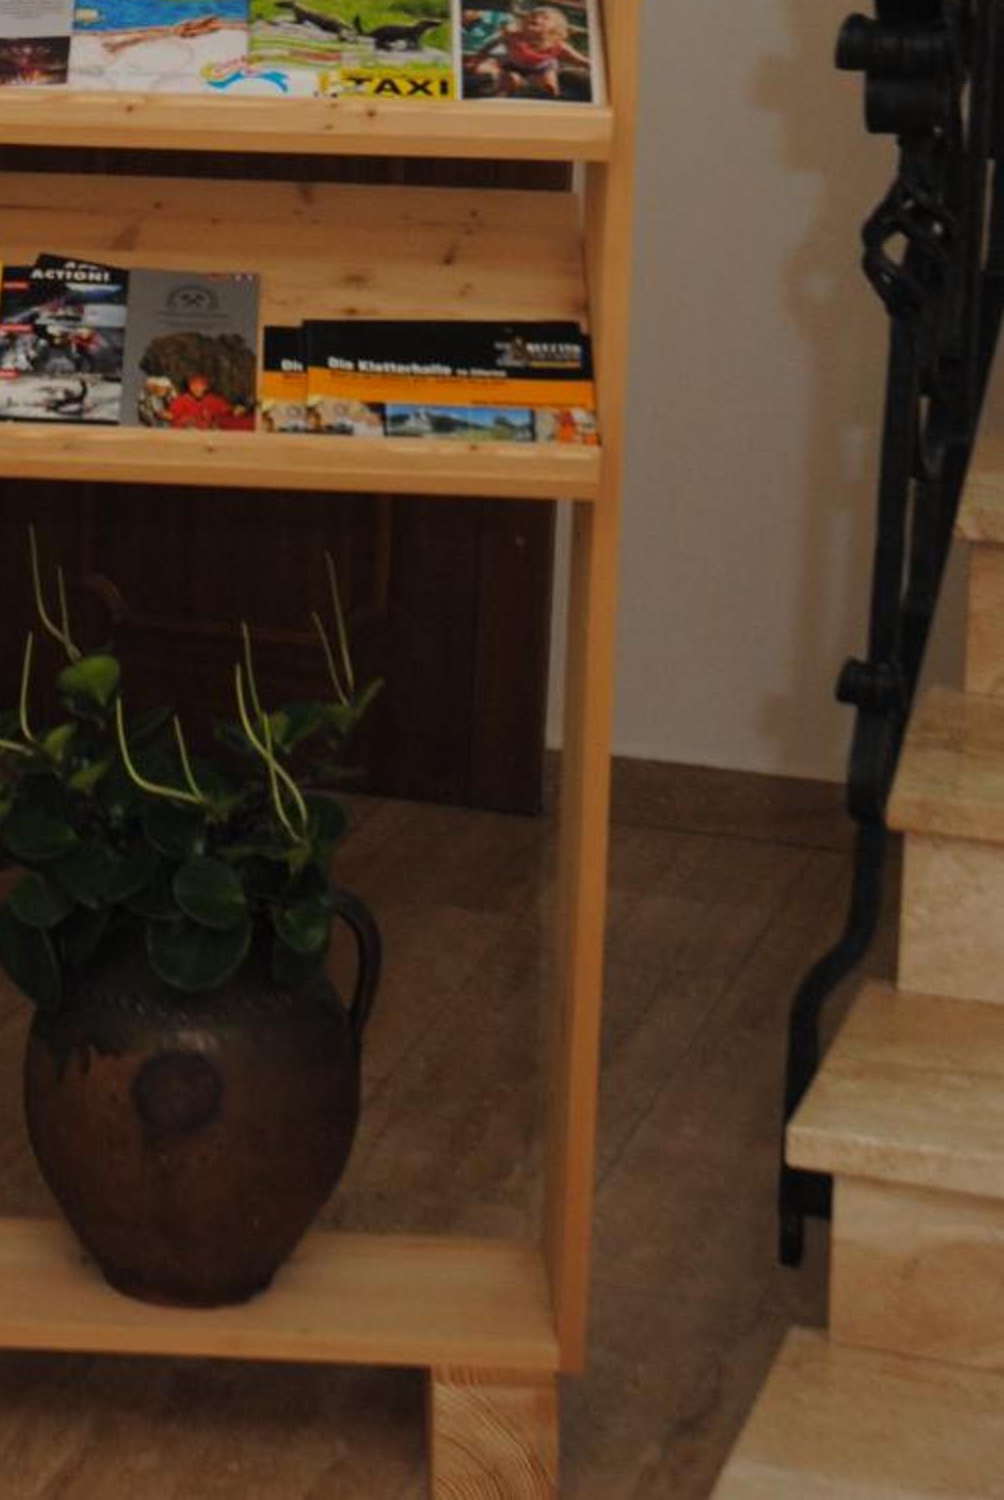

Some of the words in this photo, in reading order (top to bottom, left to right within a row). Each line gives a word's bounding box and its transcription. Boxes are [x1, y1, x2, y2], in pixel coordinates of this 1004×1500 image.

[343, 77, 450, 96] TAXI
[30, 268, 110, 283] ACTION!
[327, 356, 354, 370] Die
[357, 359, 452, 376] Kletterhalle
